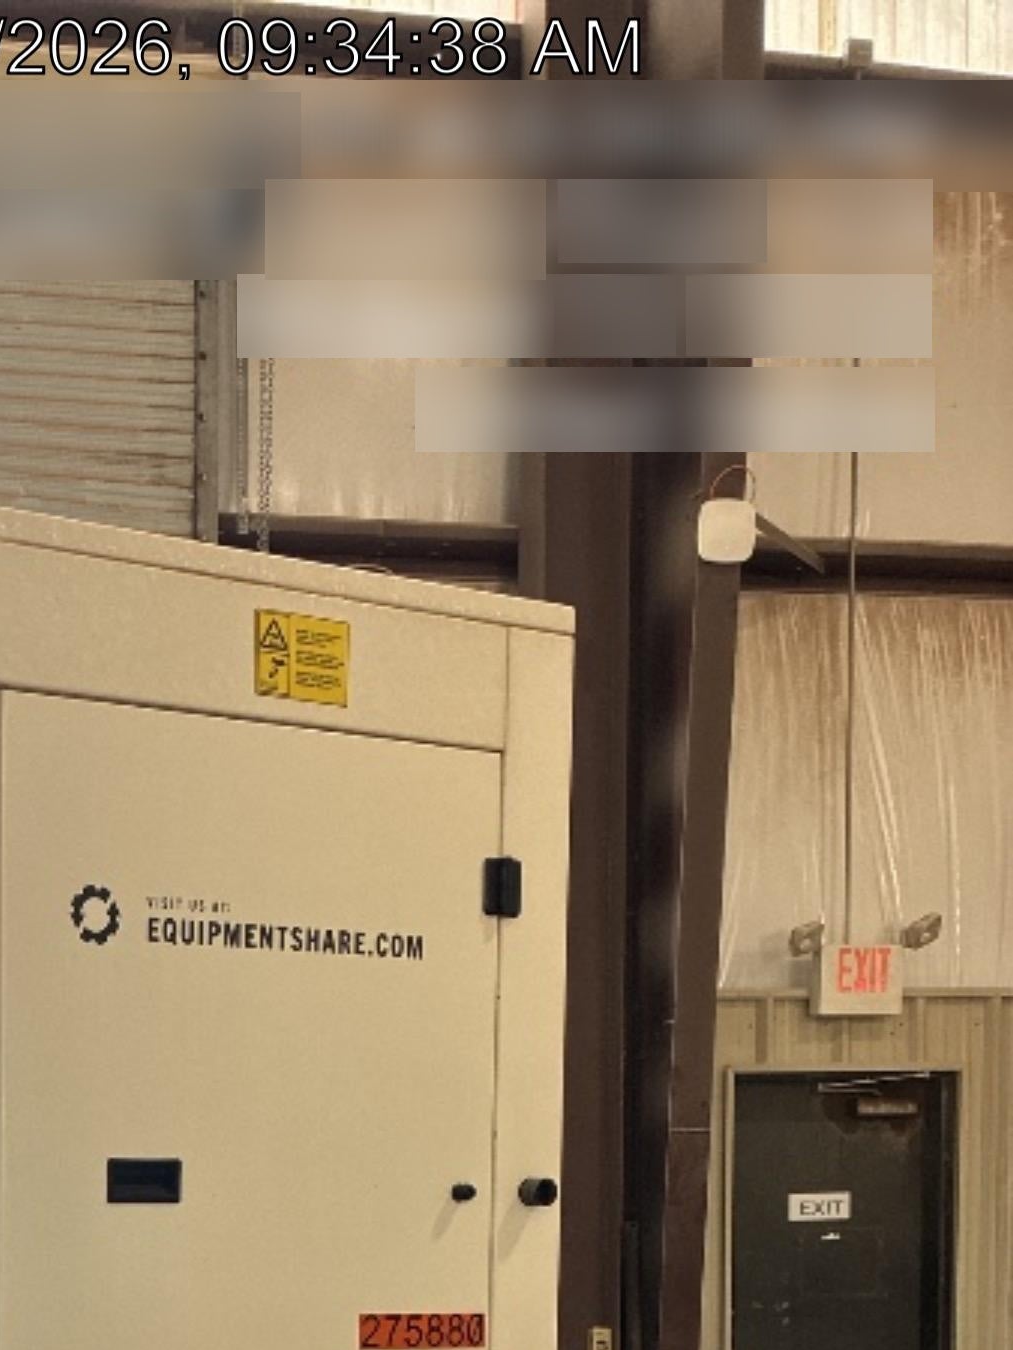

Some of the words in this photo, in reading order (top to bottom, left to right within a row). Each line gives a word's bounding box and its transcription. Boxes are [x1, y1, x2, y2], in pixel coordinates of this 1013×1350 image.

[148, 917, 423, 960] EQUIPMENTSHARE.COM
[837, 945, 891, 993] EXIT
[799, 1199, 844, 1217] EXIT
[360, 1313, 484, 1348] 275880
